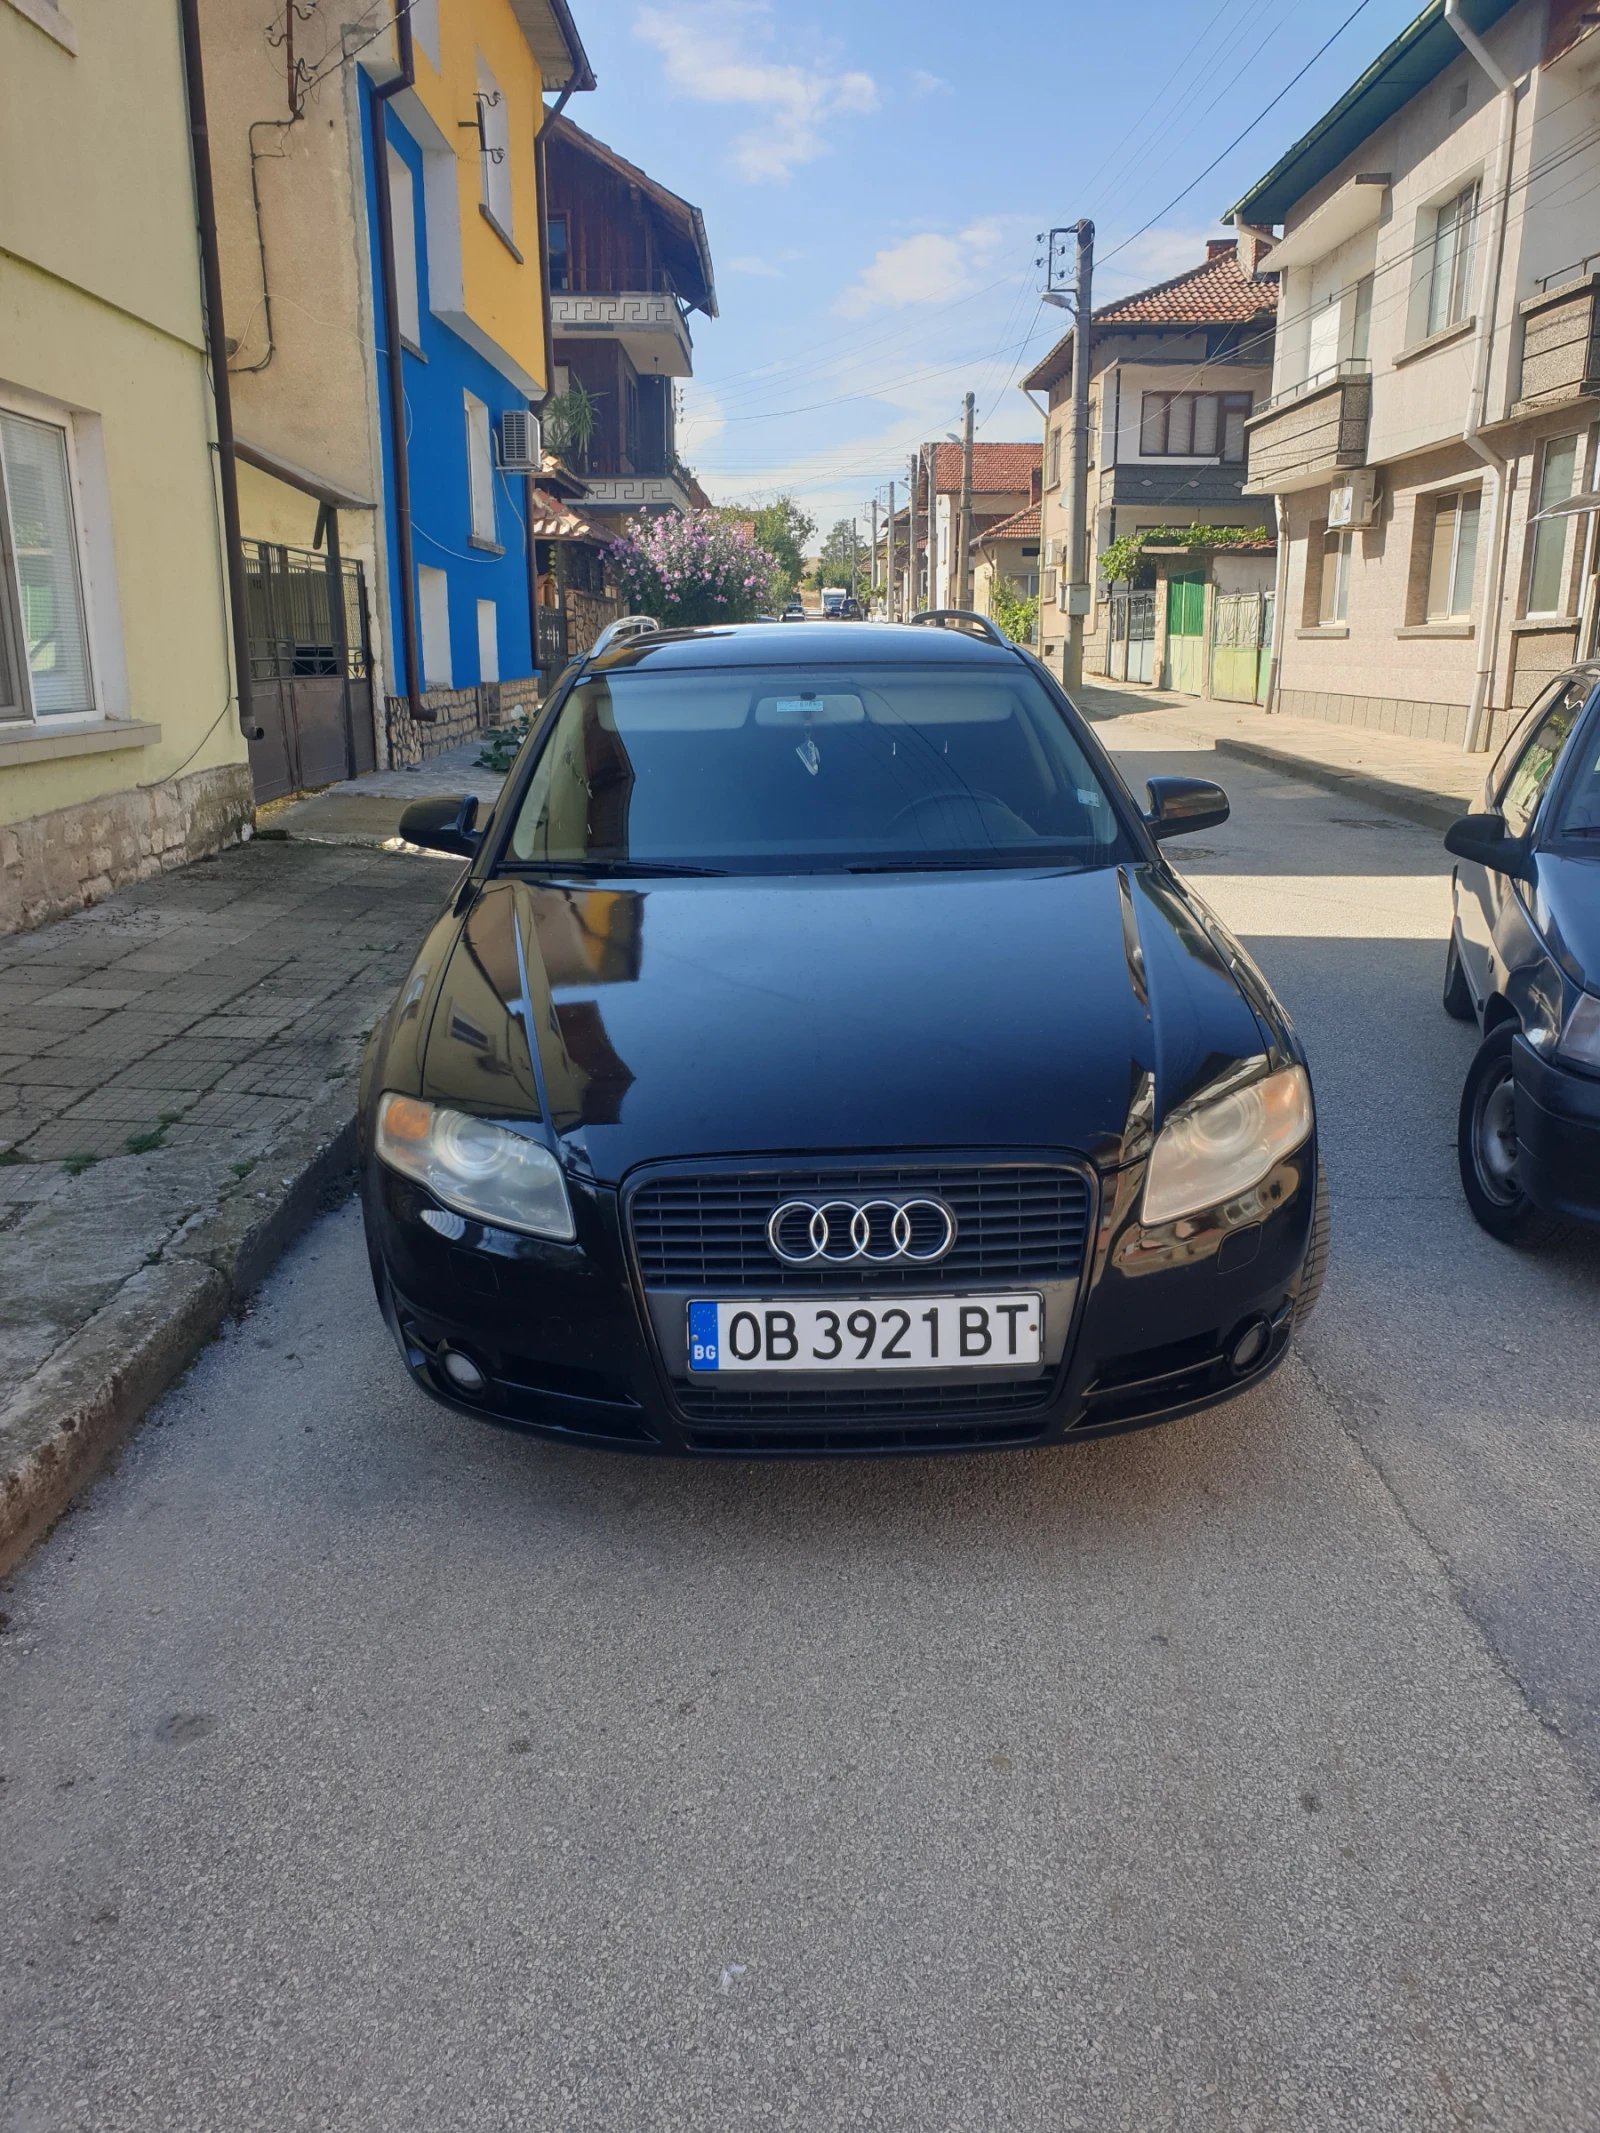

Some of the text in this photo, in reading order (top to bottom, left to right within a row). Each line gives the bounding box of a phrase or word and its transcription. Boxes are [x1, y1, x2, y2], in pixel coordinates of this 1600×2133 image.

[729, 1303, 1029, 1361] OB 3921 BT
[694, 1344, 717, 1360] BG
